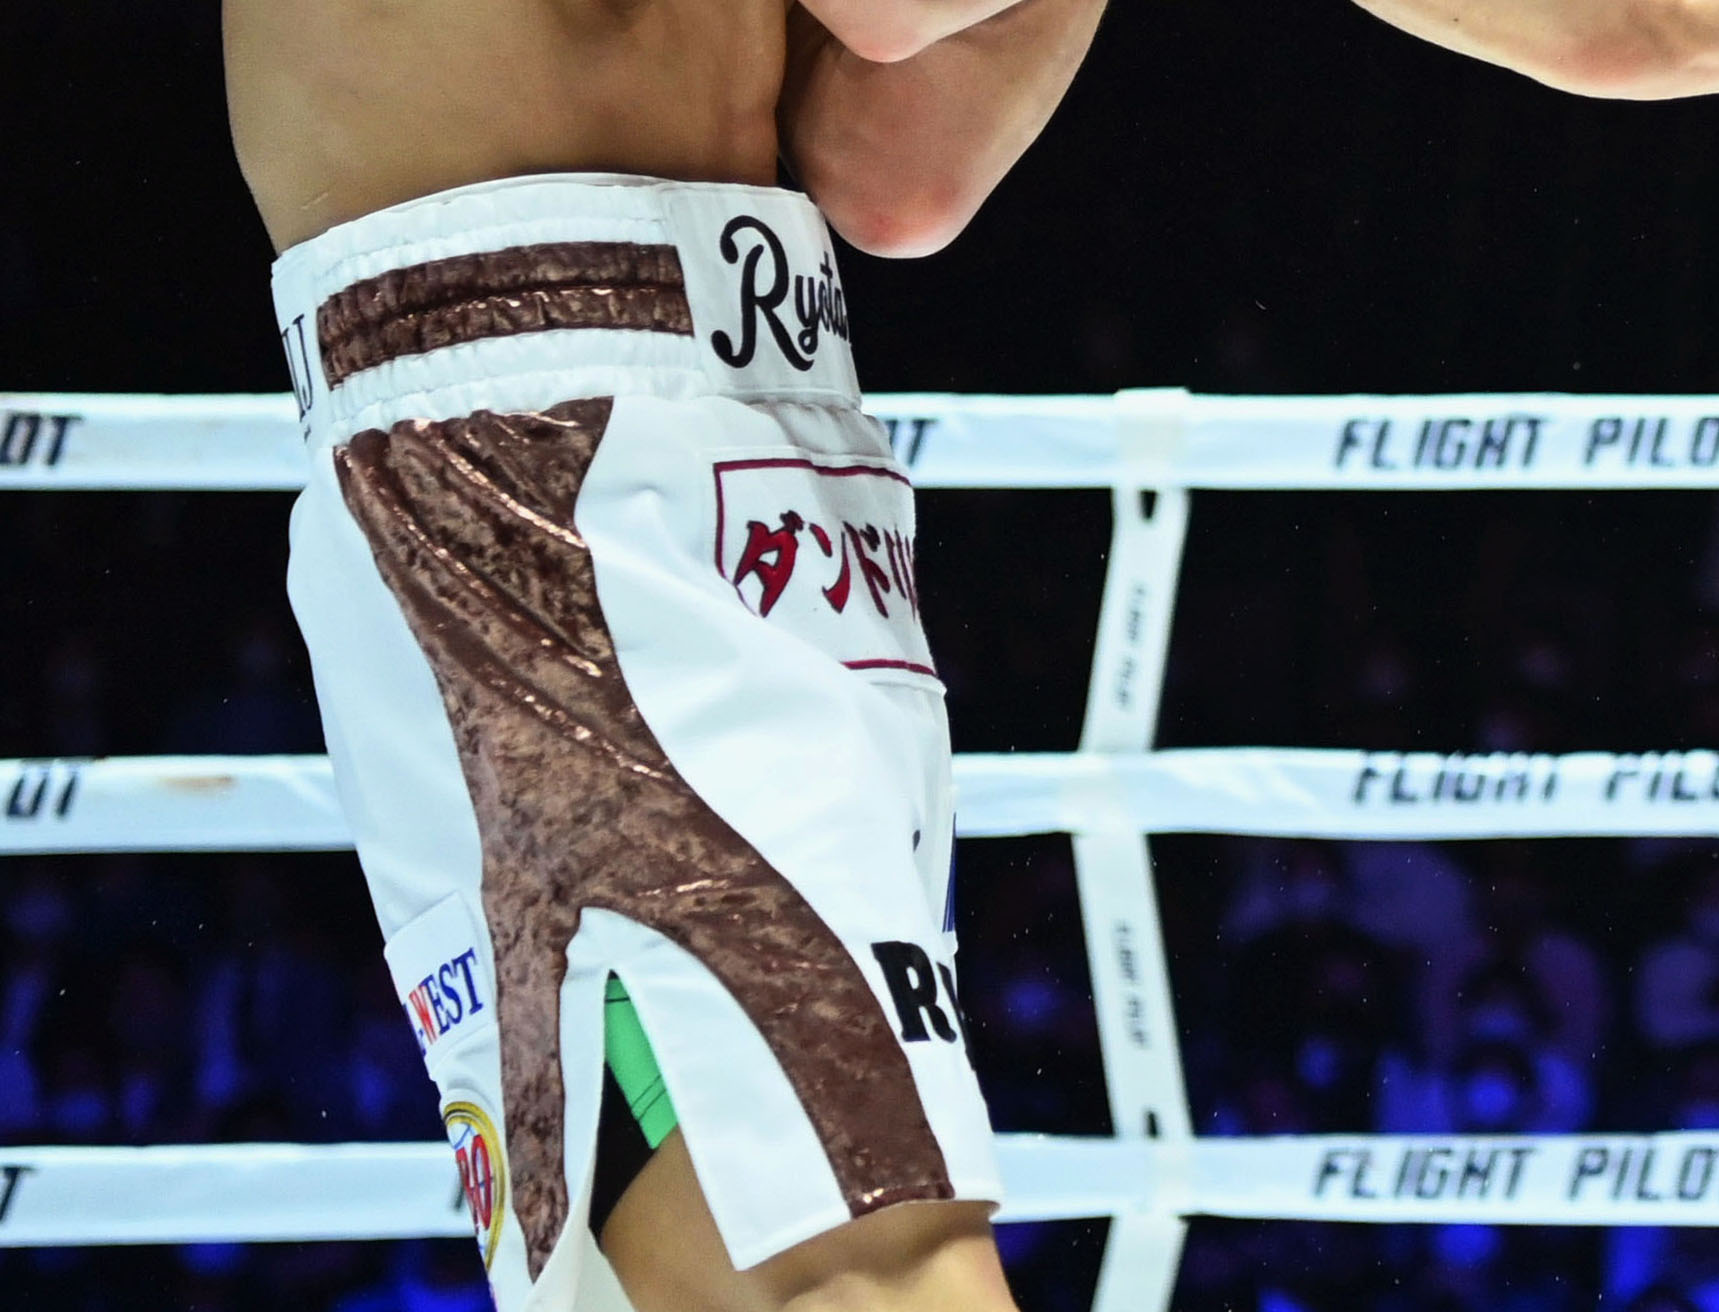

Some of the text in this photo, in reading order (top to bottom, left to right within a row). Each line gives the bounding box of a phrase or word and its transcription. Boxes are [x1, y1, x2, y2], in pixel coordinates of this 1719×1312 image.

[1336, 417, 1547, 470] FLIGHT
[403, 947, 484, 1059] WEST
[1313, 1147, 1538, 1200] FLIGHT
